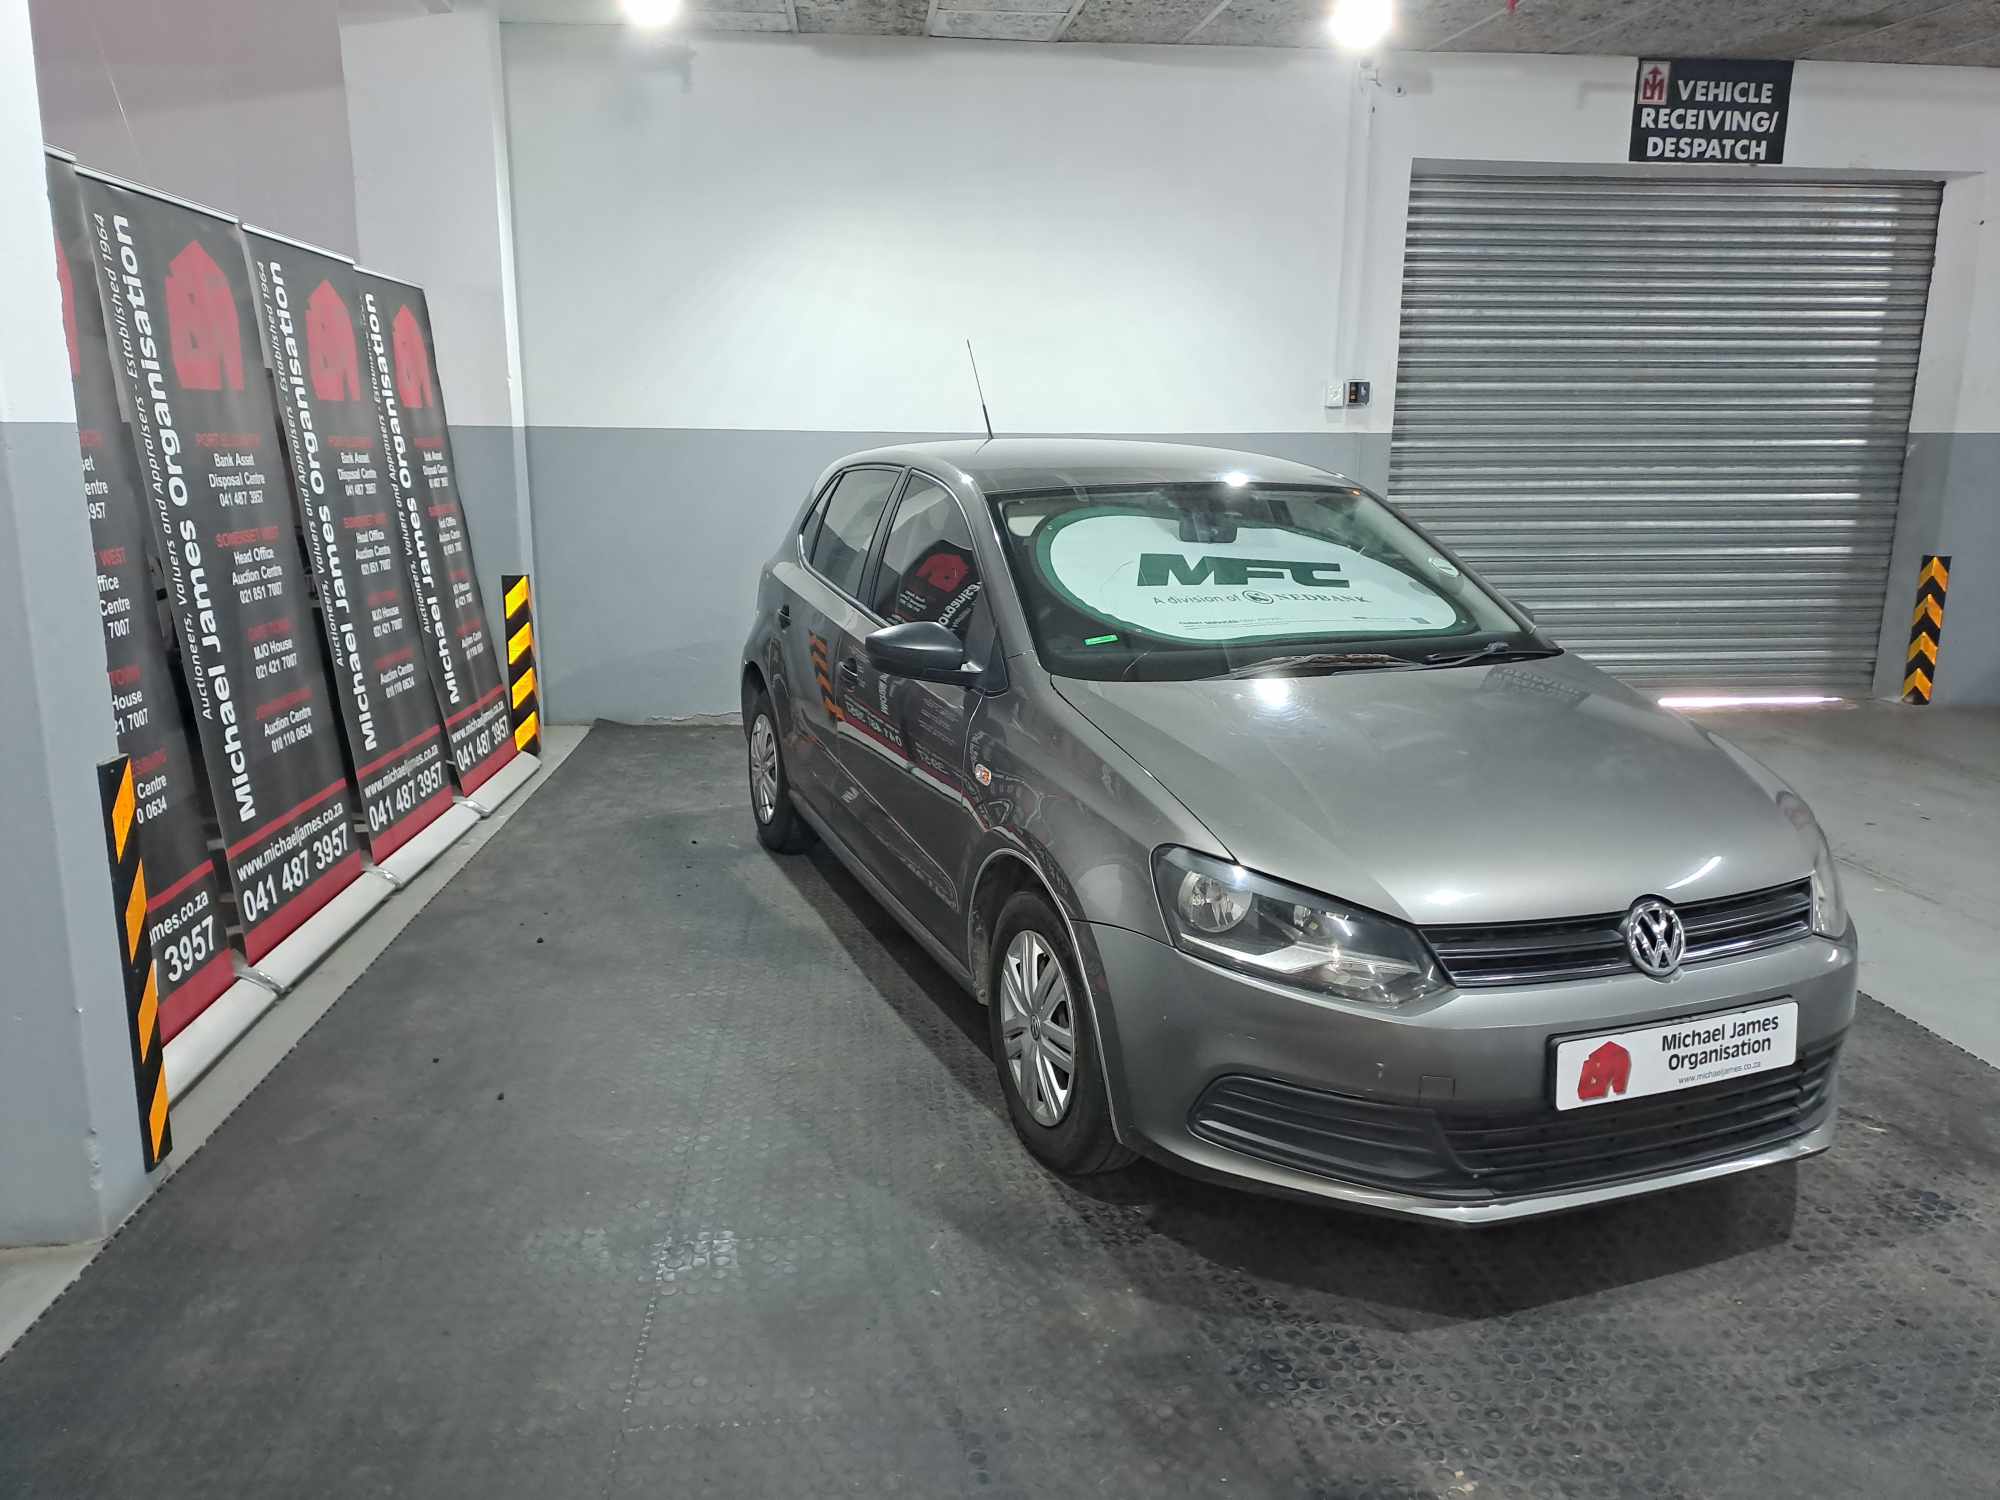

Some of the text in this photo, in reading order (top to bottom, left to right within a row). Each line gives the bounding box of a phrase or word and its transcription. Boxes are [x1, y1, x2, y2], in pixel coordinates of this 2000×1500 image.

[1678, 80, 1773, 104] VEHICLE
[1640, 107, 1779, 134] RECEIVING/
[1646, 136, 1767, 160] DESPATCH
[365, 293, 411, 488] Organisation
[93, 213, 213, 720] Auctioneers, Valuers and Appraisers Established 1964
[84, 480, 109, 496] entre
[208, 473, 243, 490] Disposal
[88, 501, 106, 520] 957
[113, 215, 256, 823] Michael James Organisation
[269, 261, 377, 751] Michael James Organisation
[407, 497, 434, 588] James
[96, 574, 119, 592] ffice
[232, 568, 260, 586] Auction
[1137, 553, 1350, 588] MFC
[253, 585, 266, 601] 851
[1167, 594, 1224, 604] division
[99, 596, 131, 617] Centre
[107, 618, 130, 639] 7007
[427, 596, 460, 704] Michael
[127, 708, 149, 731] 7007
[264, 717, 290, 737] Auction
[456, 715, 509, 771] 041 487 3957
[136, 774, 167, 799] Centre
[369, 761, 442, 831] 041 487 3957
[145, 795, 168, 820] 0634
[236, 802, 344, 882] www.michaeljames.co.za
[242, 822, 349, 922] 041 487 3957
[164, 914, 214, 982] 3957
[1662, 1016, 1779, 1052] Michael James
[1668, 1037, 1771, 1071] Organisation
